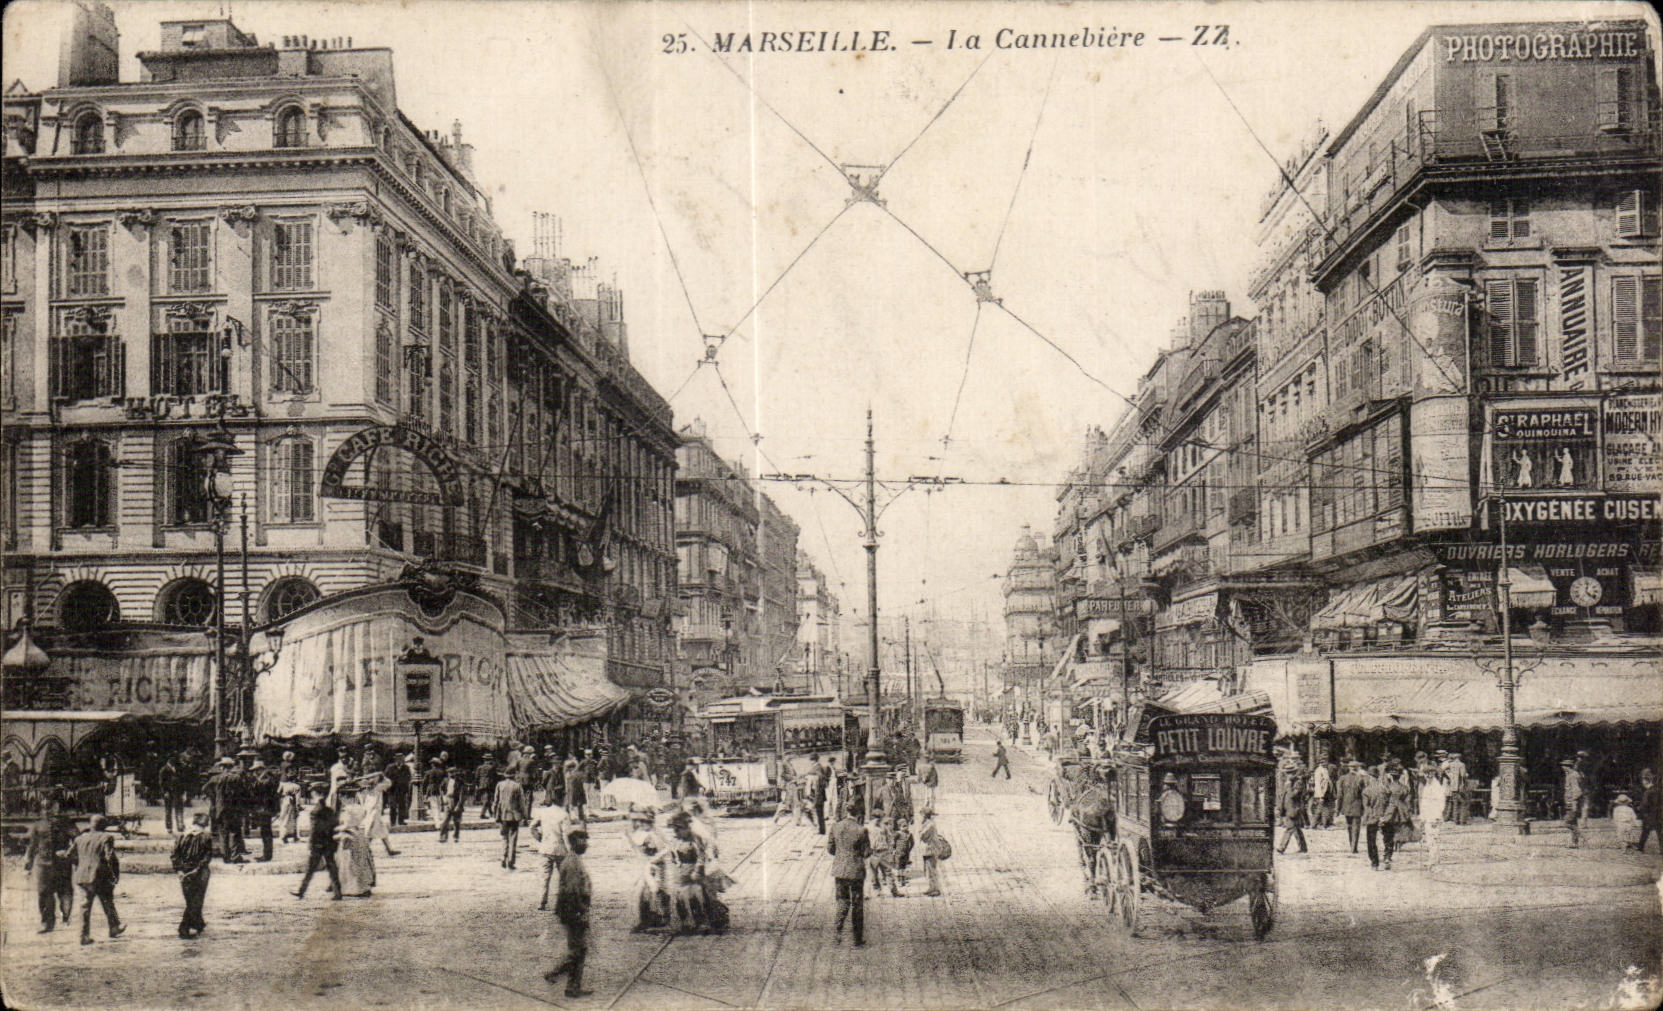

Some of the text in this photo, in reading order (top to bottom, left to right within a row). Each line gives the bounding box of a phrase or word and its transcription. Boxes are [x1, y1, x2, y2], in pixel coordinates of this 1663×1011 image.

[1445, 31, 1638, 62] PHOTOGRAPHIE
[1560, 267, 1588, 382] ANNUAIRE
[1605, 411, 1648, 435] MODERN
[1516, 428, 1577, 438] QUINQUINA
[1447, 544, 1526, 560] OUVRIERS
[1533, 543, 1630, 558] HORLOGERS
[1550, 568, 1576, 577] VENTE
[1596, 567, 1620, 576] ACHAT
[1448, 588, 1492, 602] ATELIERS
[1157, 726, 1270, 755] PETIT LOUVRE
